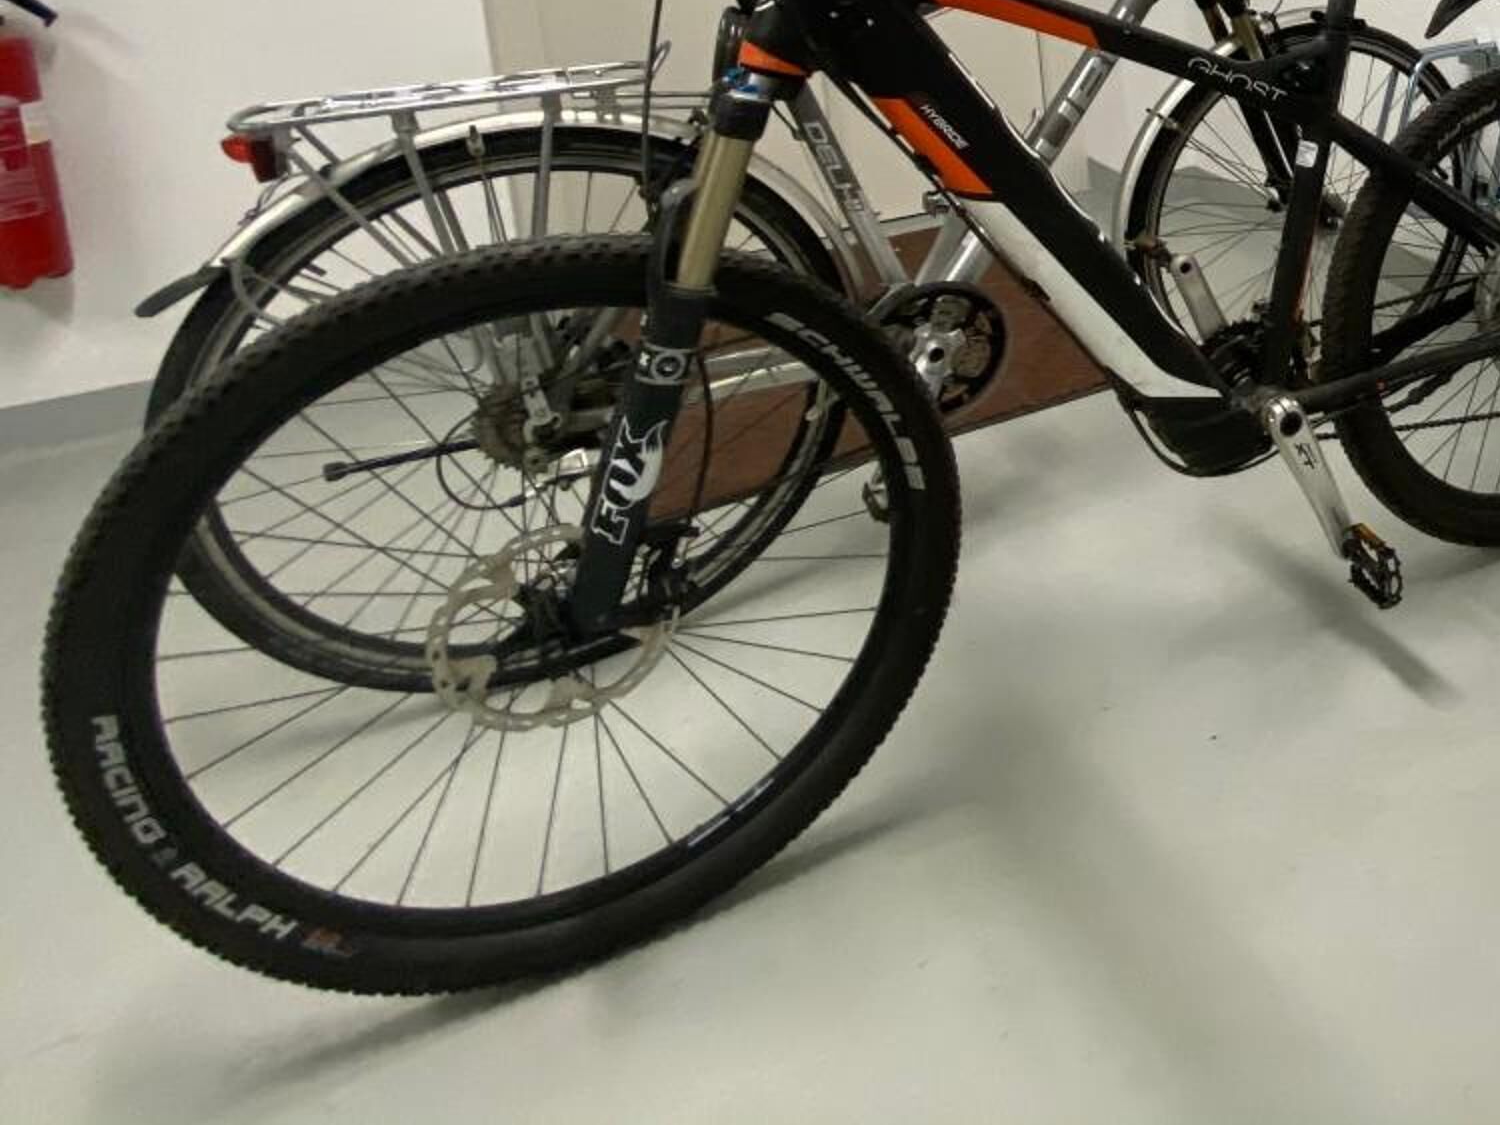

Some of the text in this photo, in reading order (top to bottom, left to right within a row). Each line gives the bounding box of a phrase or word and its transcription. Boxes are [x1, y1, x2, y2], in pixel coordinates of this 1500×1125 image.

[1187, 57, 1289, 101] GHOST
[763, 311, 927, 491] SCHWALBE
[591, 414, 668, 546] FOX
[91, 714, 299, 941] RACING RALPH
